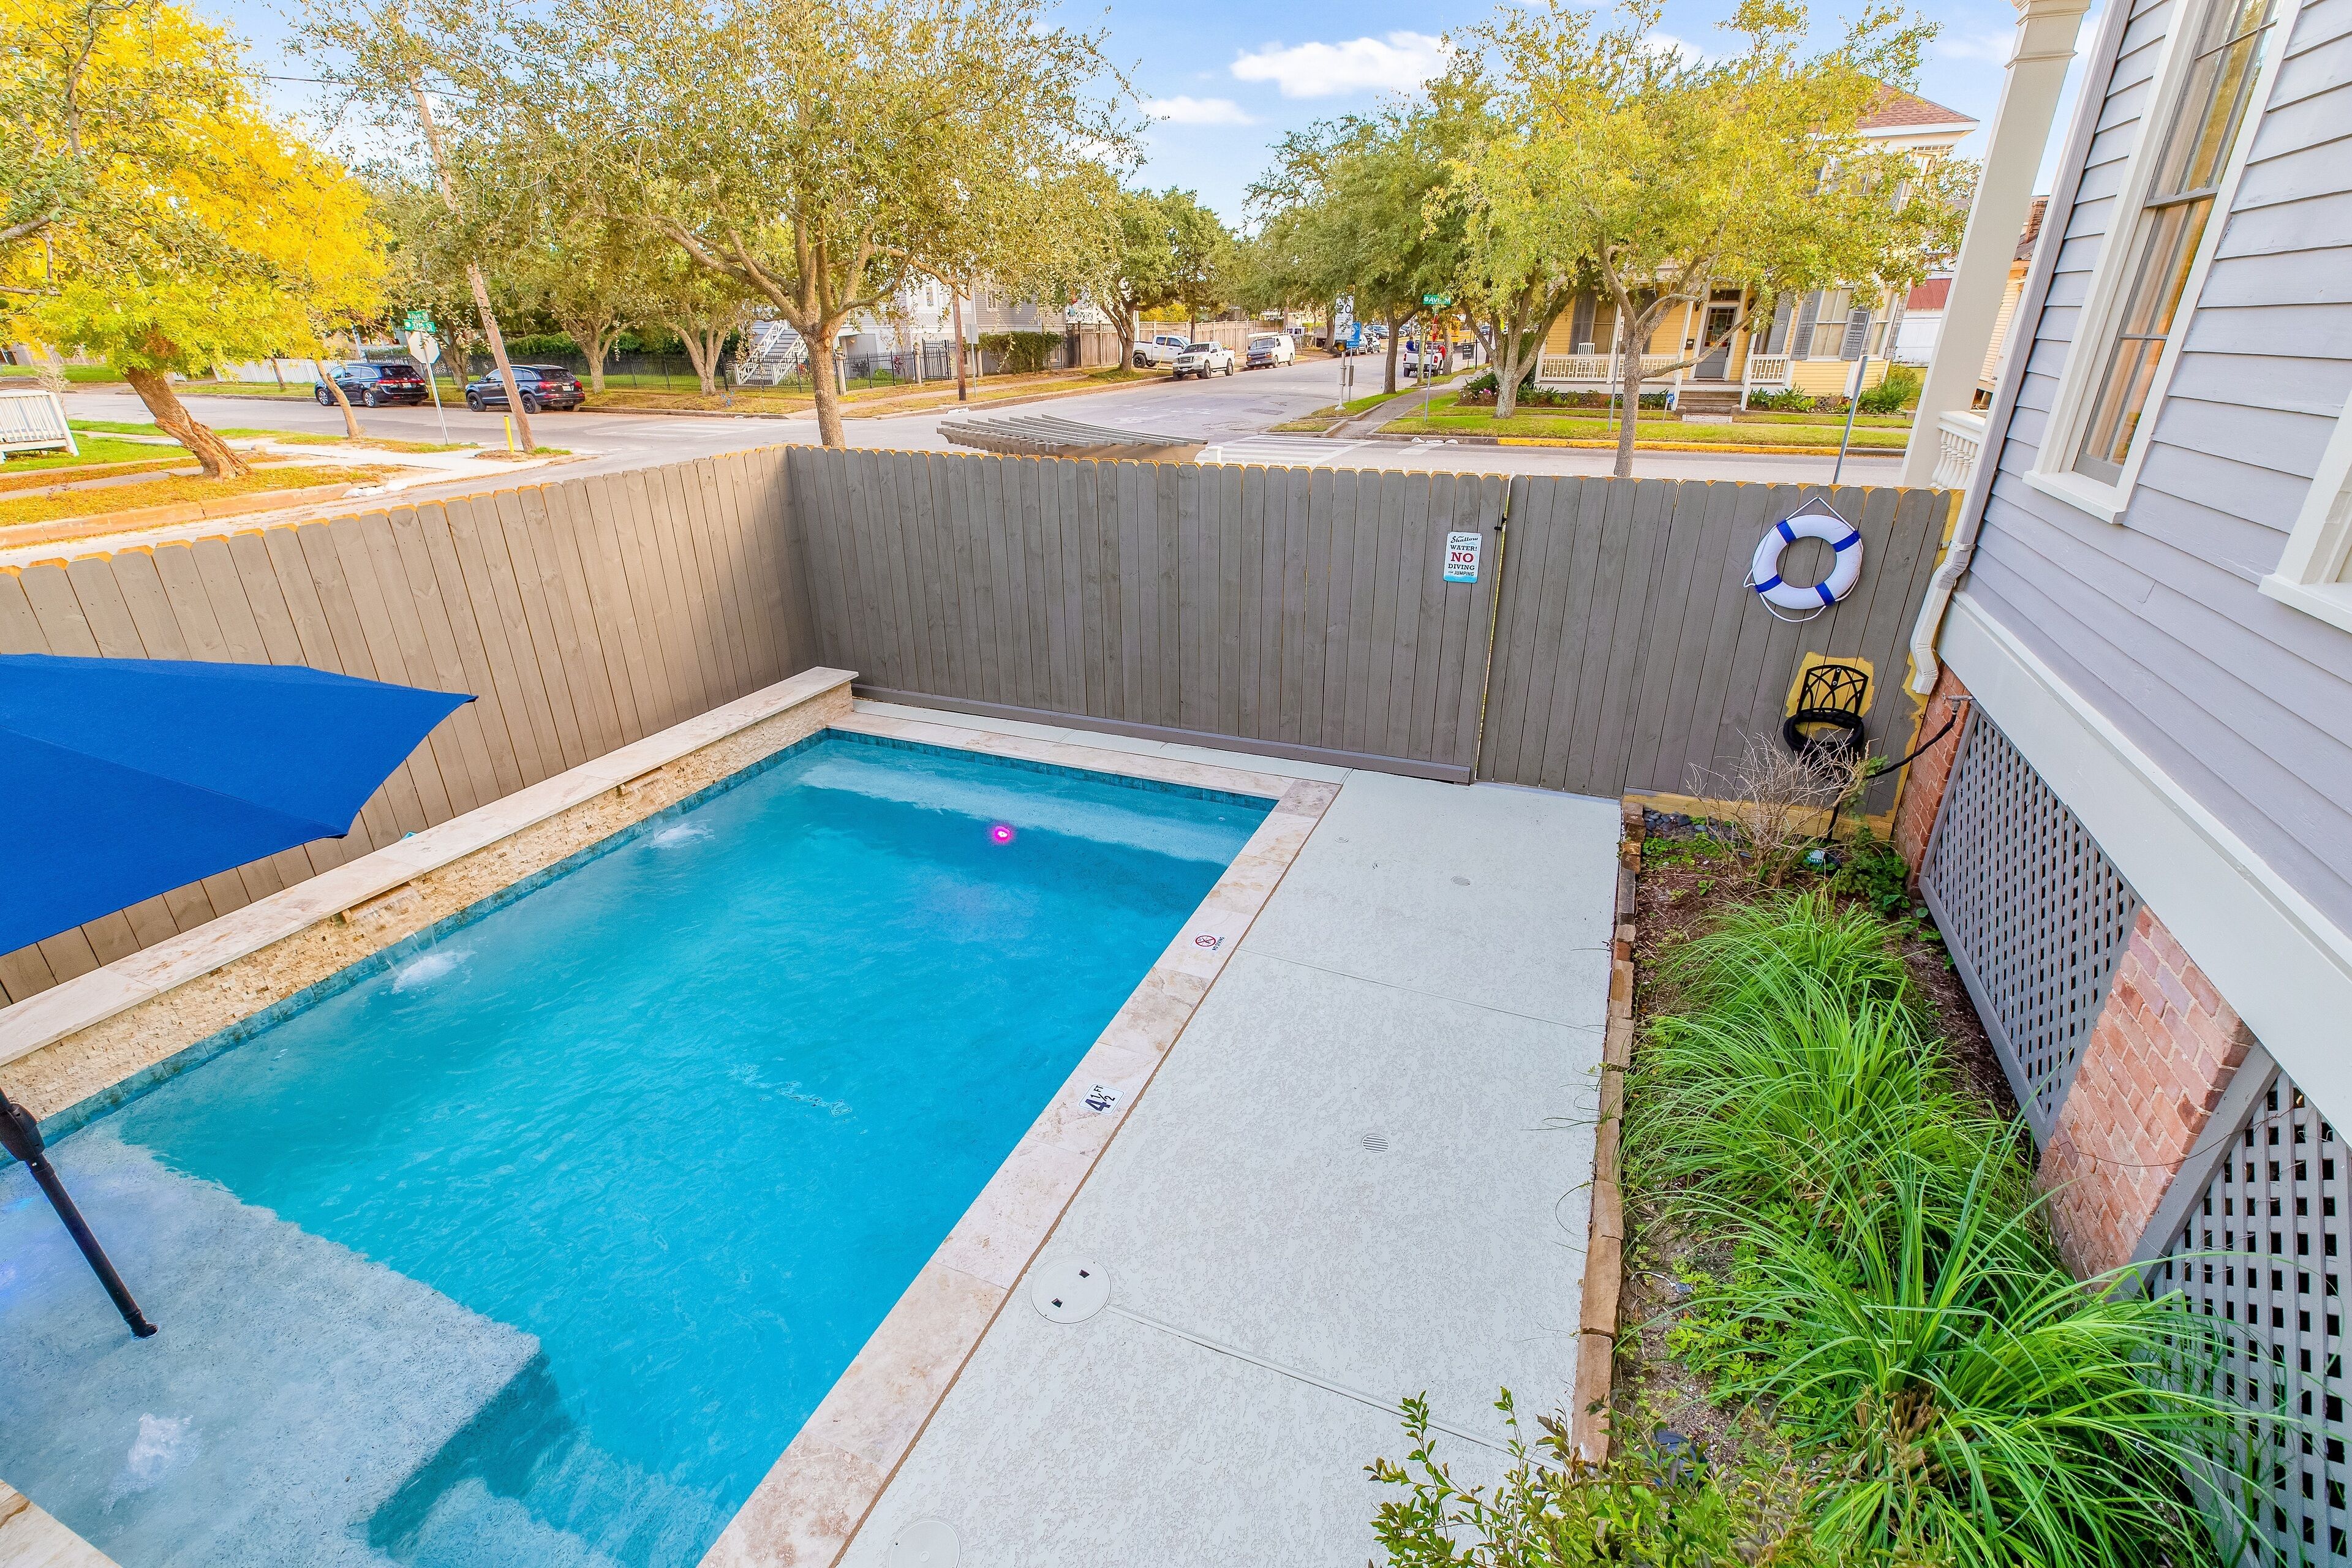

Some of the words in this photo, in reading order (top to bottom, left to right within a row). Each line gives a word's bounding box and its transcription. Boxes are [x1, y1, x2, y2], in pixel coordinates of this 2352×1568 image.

[1336, 304, 1351, 314] 20
[1450, 552, 1474, 563] NO
[1215, 937, 1224, 946] DIVING
